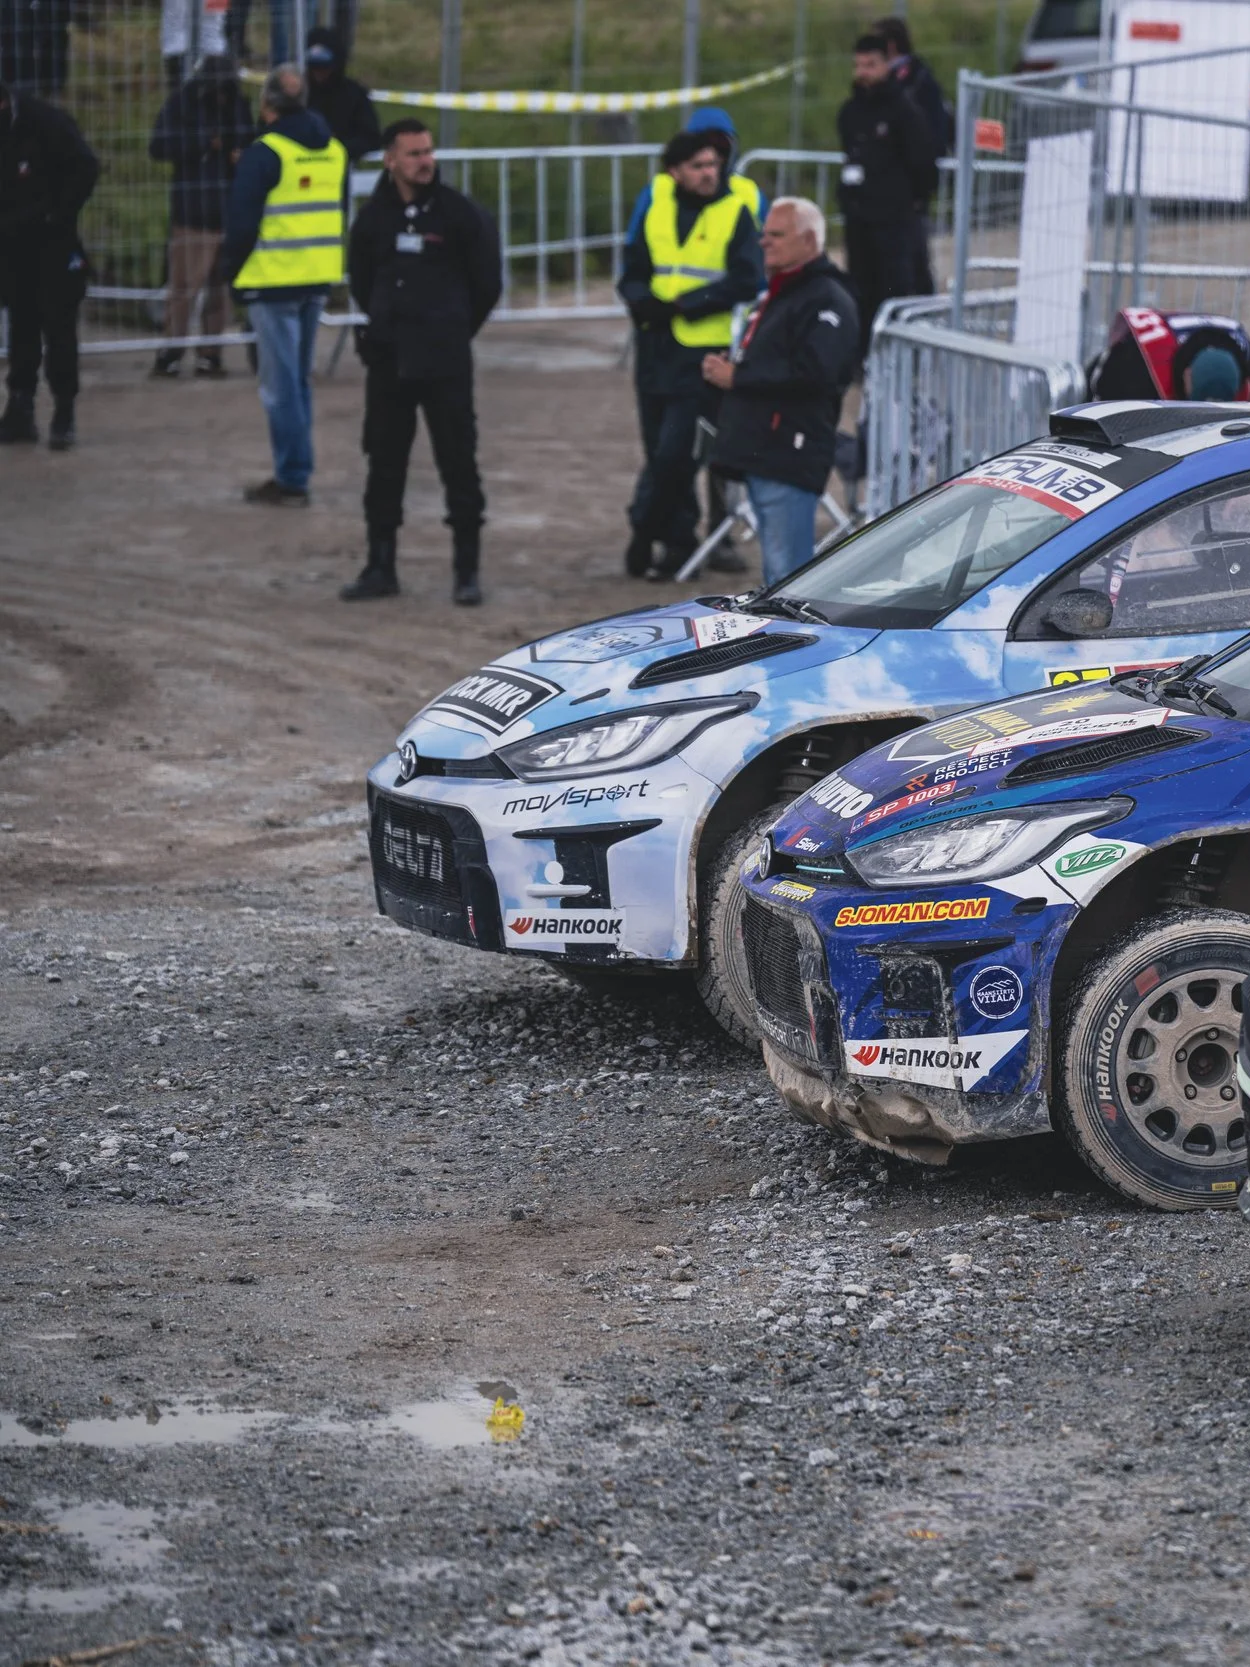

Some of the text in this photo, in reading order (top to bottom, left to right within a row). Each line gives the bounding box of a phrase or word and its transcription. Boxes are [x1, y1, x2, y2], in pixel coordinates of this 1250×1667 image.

[933, 758, 1012, 784] PROJECT
[935, 751, 1014, 775] RESPECT
[502, 779, 650, 816] movisport
[867, 802, 898, 822] SP
[907, 783, 952, 804] 1003
[795, 837, 822, 853] Sievi
[1060, 846, 1125, 874] VIITA
[834, 897, 991, 927] SJOMAN.COM
[976, 993, 1016, 1004] VIIALA
